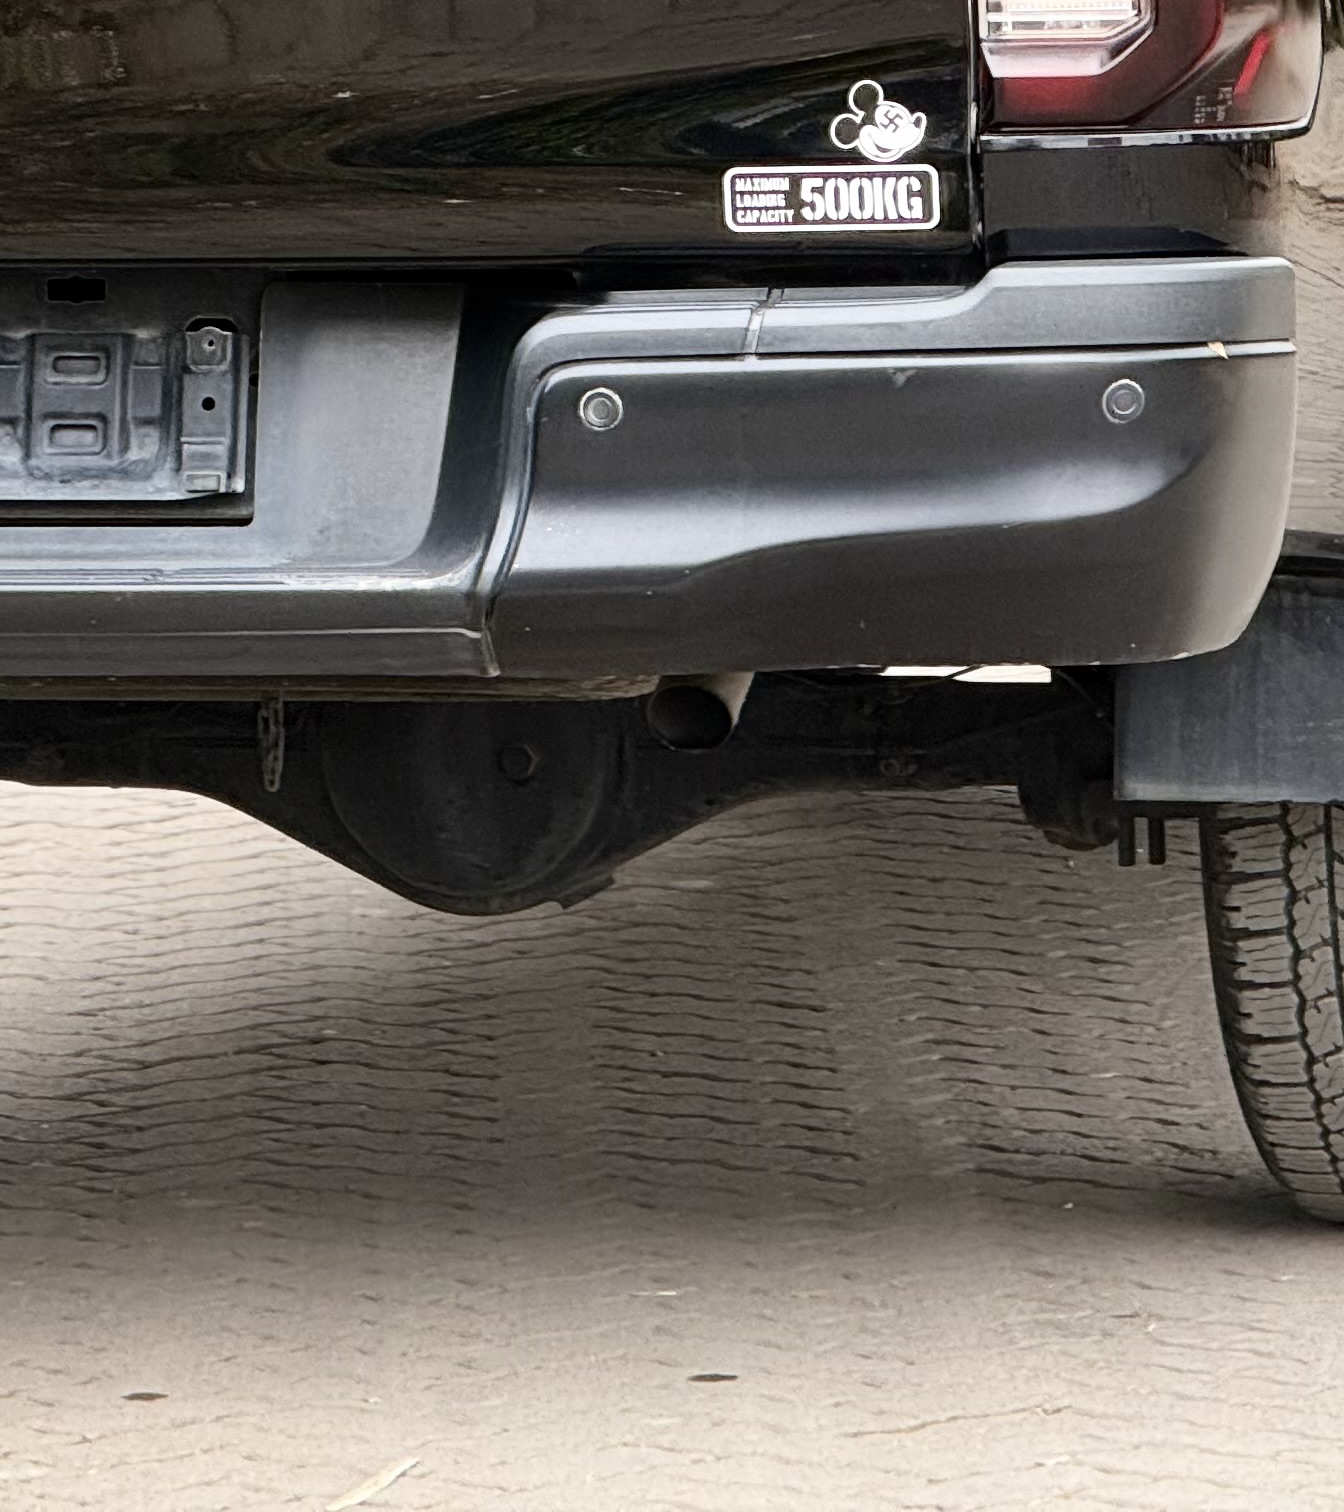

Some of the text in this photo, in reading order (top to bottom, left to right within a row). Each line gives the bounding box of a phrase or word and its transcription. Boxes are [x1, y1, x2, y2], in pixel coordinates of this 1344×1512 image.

[735, 177, 790, 192] MAXIMUM
[736, 193, 787, 207] LOADING
[800, 175, 924, 221] 500KG
[736, 209, 795, 223] CAPACITY
